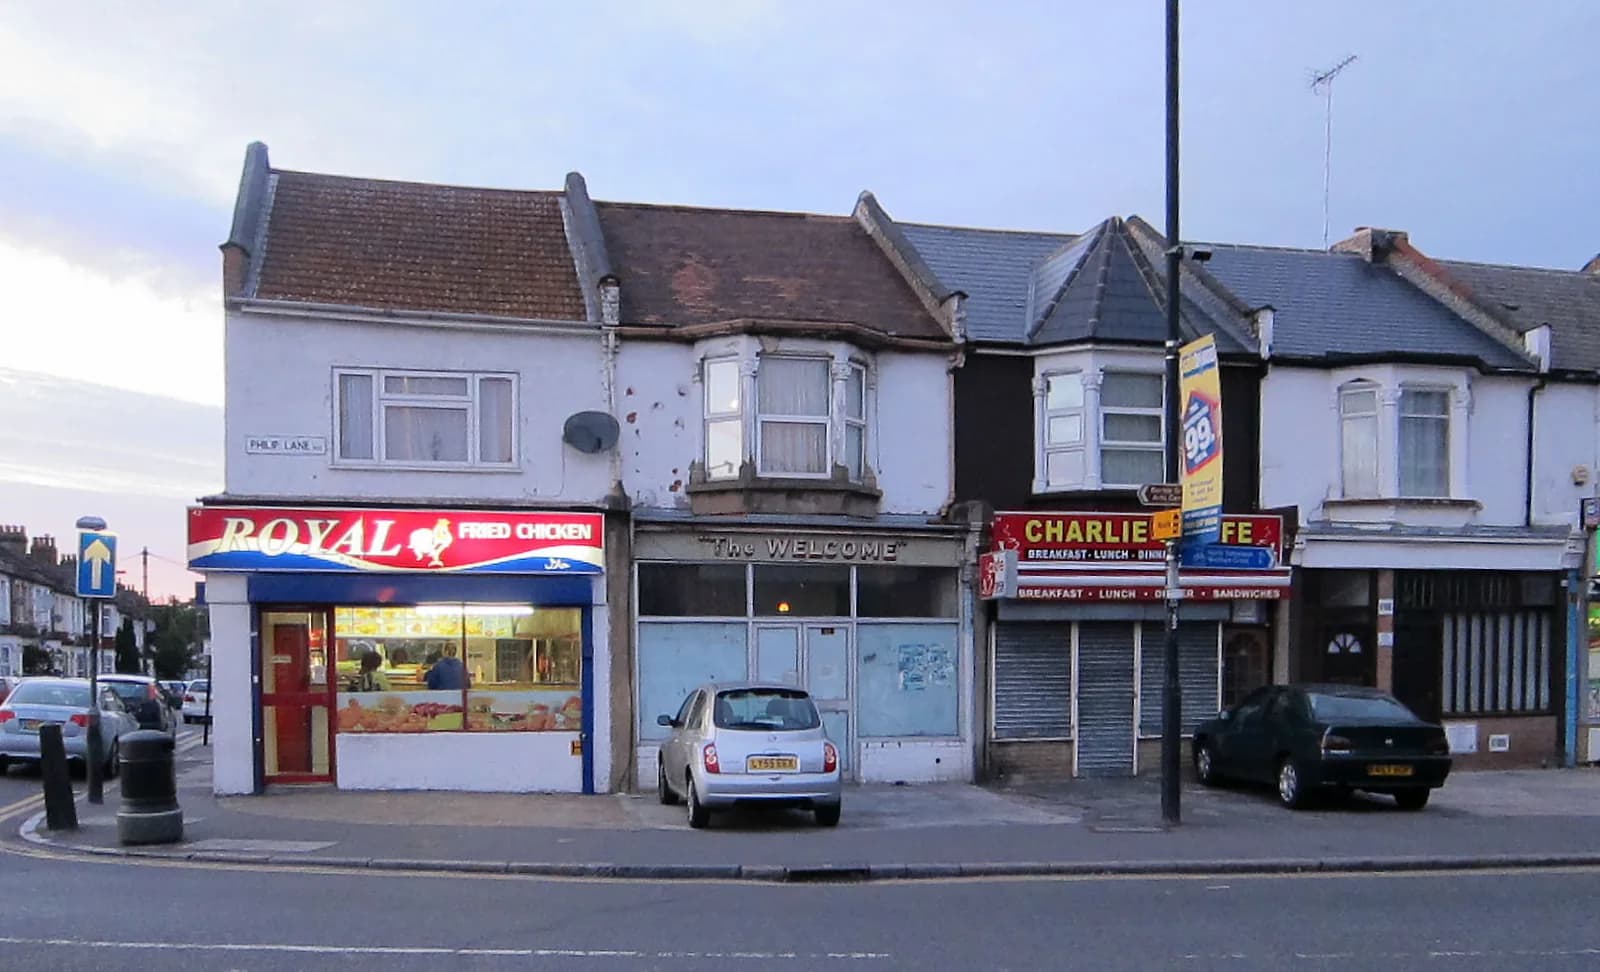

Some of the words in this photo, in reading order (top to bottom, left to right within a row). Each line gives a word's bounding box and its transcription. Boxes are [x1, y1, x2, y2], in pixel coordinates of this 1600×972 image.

[250, 439, 278, 449] PHILIP
[284, 440, 311, 450] LANE
[215, 517, 402, 558] ROYAL
[458, 521, 511, 540] FRIED
[516, 523, 592, 540] CHICKEN
[1025, 519, 1149, 543] CHARLIE
[1222, 521, 1253, 544] FE
[1027, 549, 1088, 559] BREAKFAST
[1094, 550, 1129, 559] LUNCH
[1138, 550, 1166, 560] DINN
[1018, 588, 1083, 599] BREAKFAST
[1099, 589, 1136, 599] LUNCH
[1212, 589, 1281, 599] SANDWICHES
